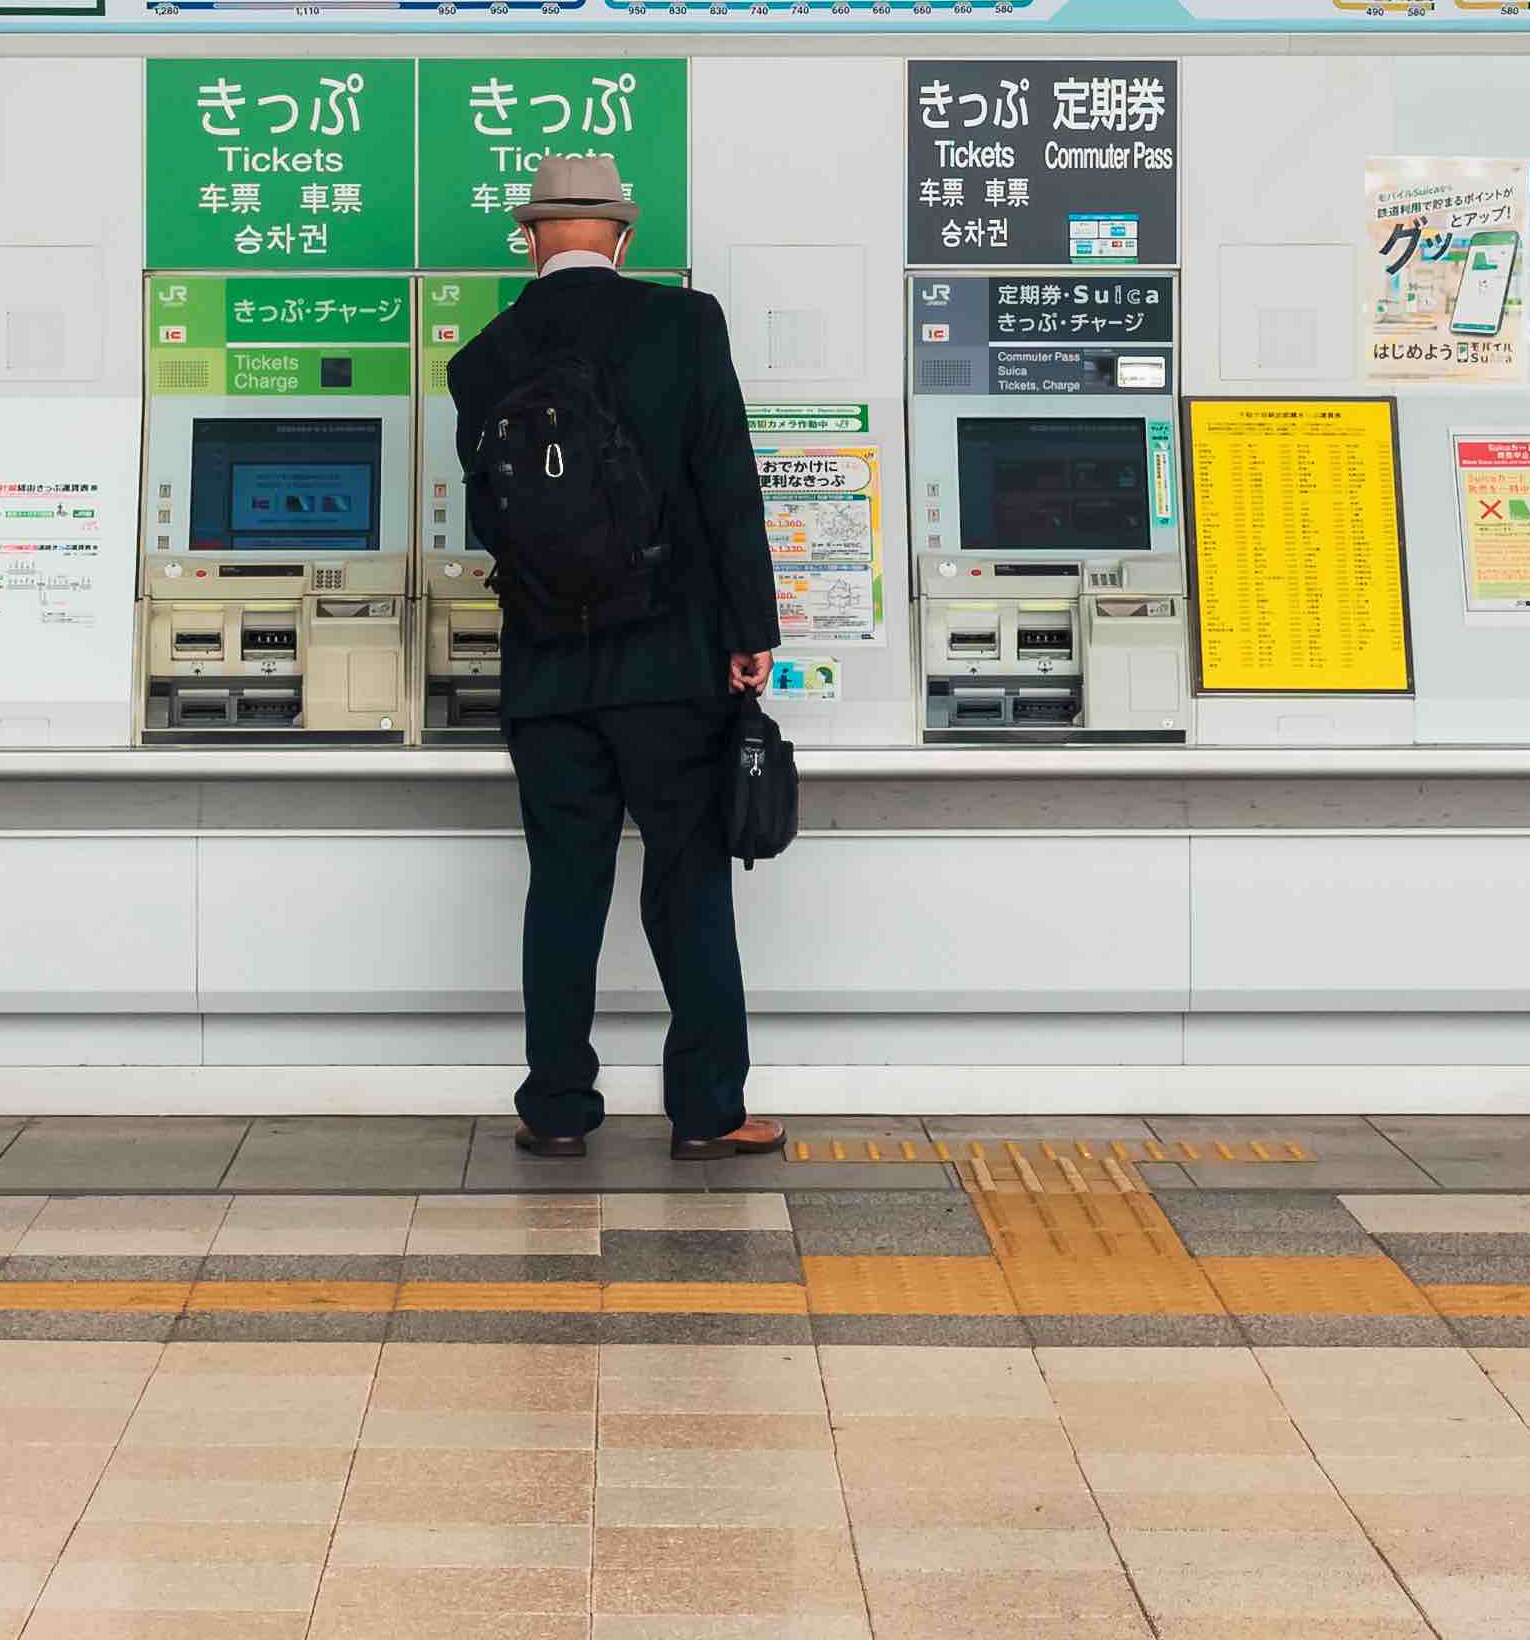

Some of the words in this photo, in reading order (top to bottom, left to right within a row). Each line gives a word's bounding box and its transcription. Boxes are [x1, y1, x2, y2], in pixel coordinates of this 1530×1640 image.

[197, 73, 364, 136] きっぷ
[470, 73, 637, 136] きっぷ
[919, 79, 1030, 129] きっぷ
[1053, 77, 1165, 131] 定期券
[219, 147, 343, 173] Tickets
[935, 141, 1014, 168] Tickets
[1045, 142, 1130, 169] Commuter
[1134, 142, 1172, 169] Pass
[198, 183, 262, 213] 车票
[300, 183, 362, 213] 車票
[920, 178, 964, 207] 车票
[985, 178, 1030, 207] 車票
[234, 224, 328, 254] 승차권
[941, 218, 1008, 247] 승차권
[159, 286, 188, 304] JR
[432, 286, 460, 304] JR
[922, 285, 950, 301] JR
[998, 351, 1051, 362] Commuter
[1054, 352, 1080, 361] Pass
[1374, 344, 1453, 361] はじめよう
[234, 355, 299, 371] Tickets
[998, 366, 1027, 376] Suica
[234, 373, 298, 391] Charge
[1043, 381, 1080, 392] Charge
[763, 461, 838, 473] おでかけに
[759, 474, 845, 488] 便利なきっぷ
